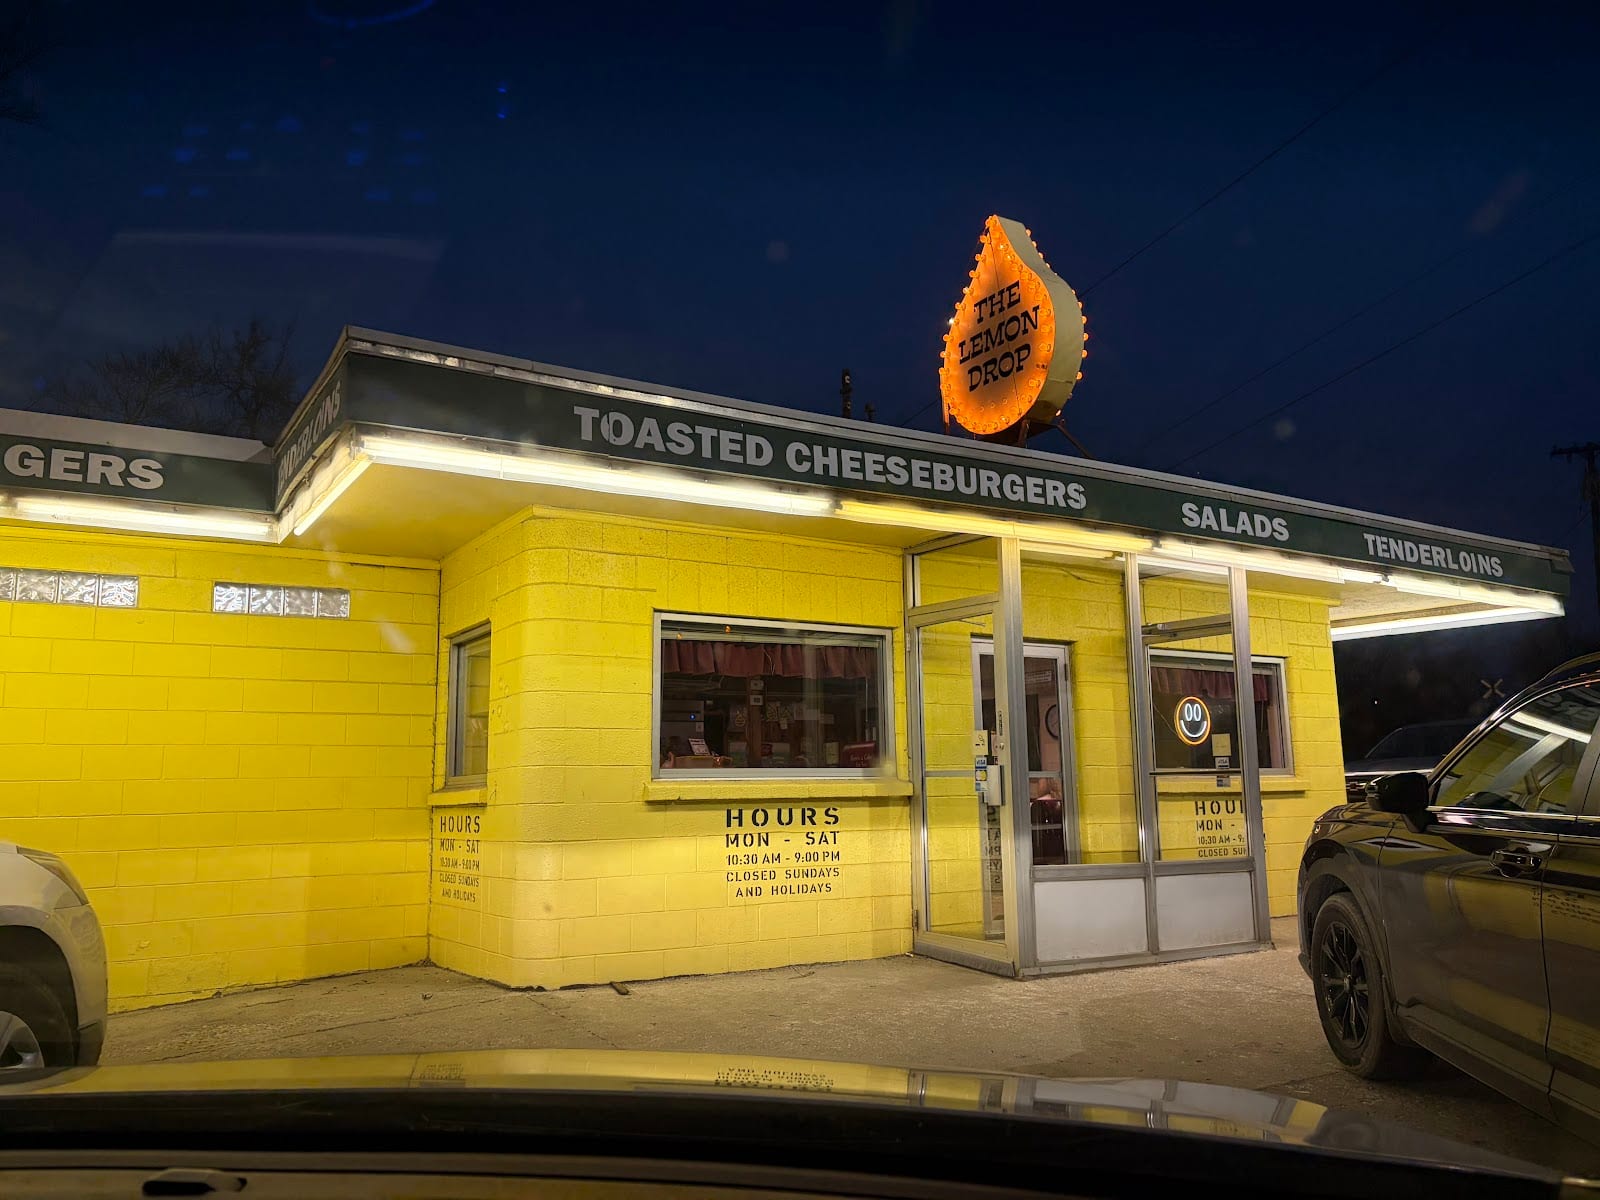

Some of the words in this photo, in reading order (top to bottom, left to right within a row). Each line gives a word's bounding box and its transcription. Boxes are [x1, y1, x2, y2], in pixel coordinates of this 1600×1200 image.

[973, 280, 1021, 324] THE
[958, 305, 1040, 364] LEMON
[967, 343, 1031, 392] DROP
[3, 444, 164, 490] GERS
[573, 406, 774, 467] TOASTED
[785, 441, 1087, 511] CHEESEBURGERS
[1181, 502, 1290, 541] SALADS
[1363, 532, 1504, 578] TENDERLOINS
[1194, 799, 1244, 815] HOU
[440, 815, 480, 833] HOURS
[726, 807, 839, 828] HOURS
[1196, 819, 1223, 831] MON
[440, 838, 455, 851] MON
[466, 839, 480, 854] SAT
[725, 832, 769, 848] MON
[805, 831, 840, 845] SAT
[1218, 833, 1231, 844] AM
[726, 853, 758, 866] 10:30
[762, 852, 781, 864] AM
[794, 851, 819, 863] 9:00
[822, 851, 840, 862] PM
[1198, 848, 1229, 857] CLOSED
[726, 870, 776, 882] CLOSED
[785, 867, 840, 879] SUNDAYS
[735, 886, 762, 897] AND
[771, 883, 832, 895] HOLIDAYS
